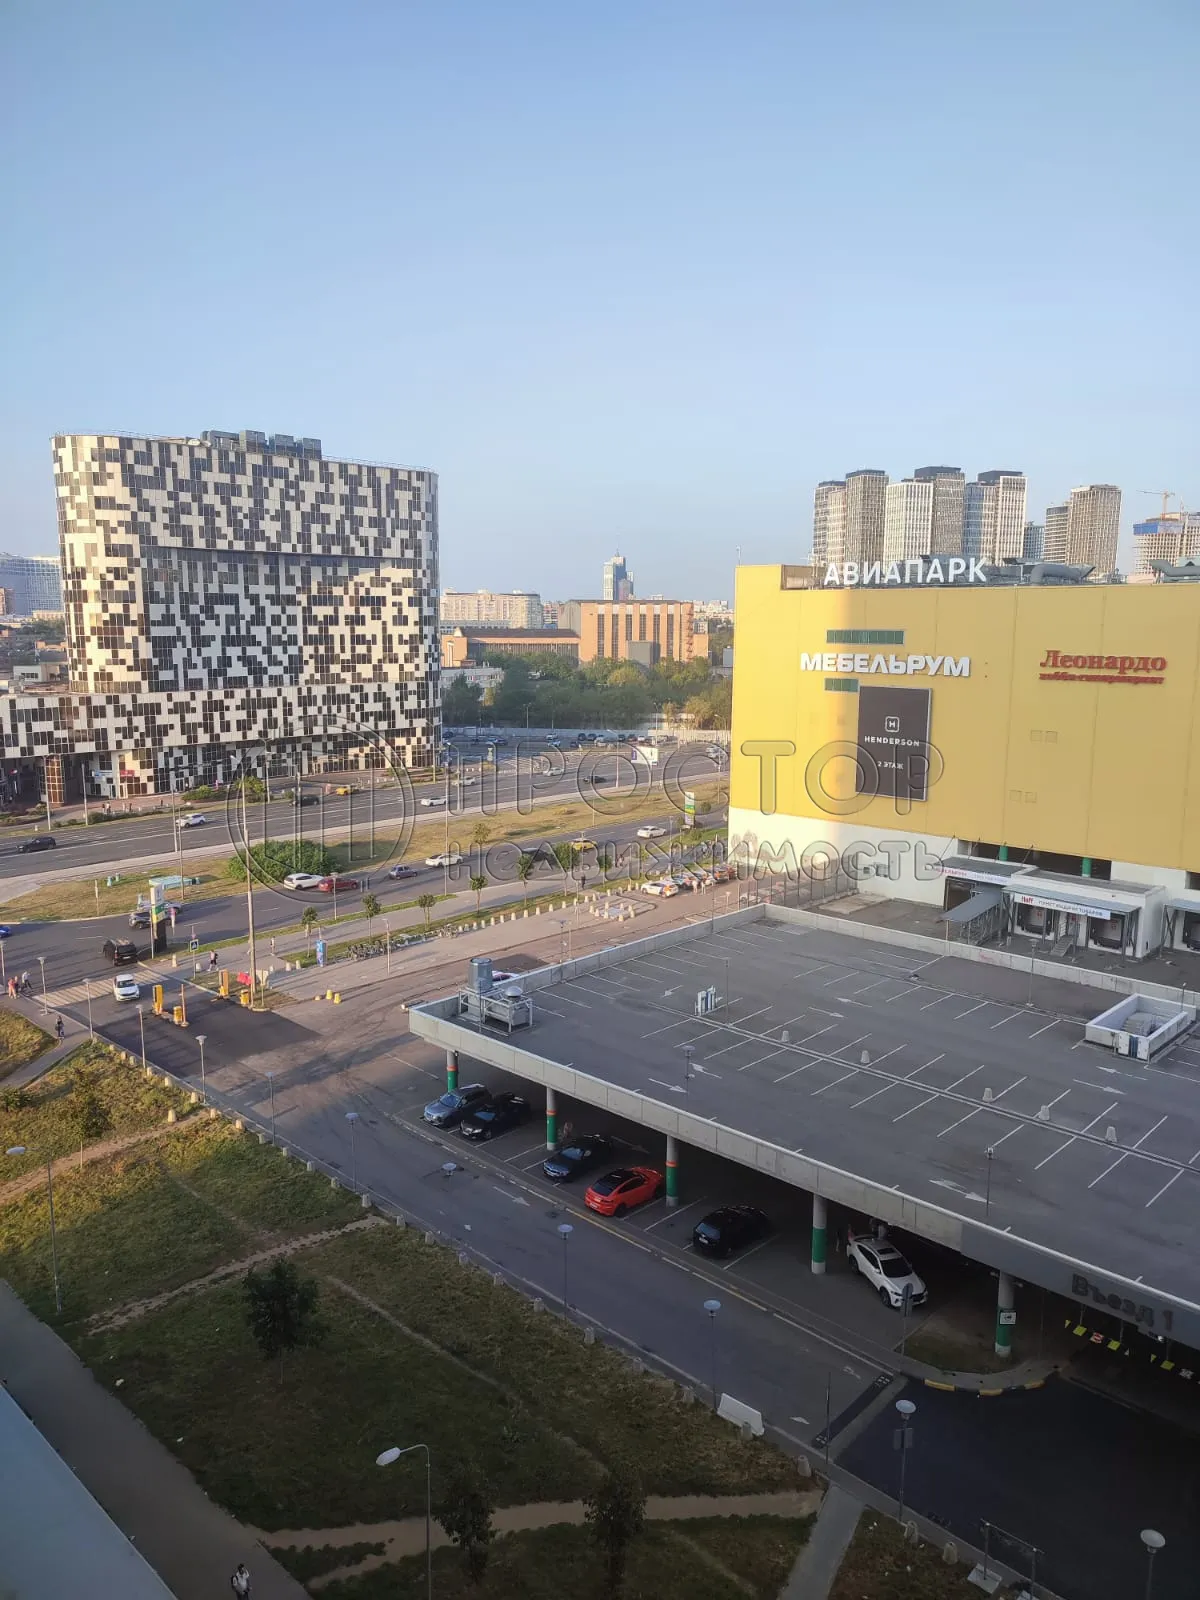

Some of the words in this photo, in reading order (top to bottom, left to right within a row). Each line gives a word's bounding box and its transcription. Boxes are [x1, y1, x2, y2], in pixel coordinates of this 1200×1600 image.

[823, 557, 987, 586] АВИАПАРК
[800, 652, 971, 677] МЕБЕЛЬРУМ
[1039, 650, 1167, 674] Леонардо
[864, 735, 920, 747] HENDERSON
